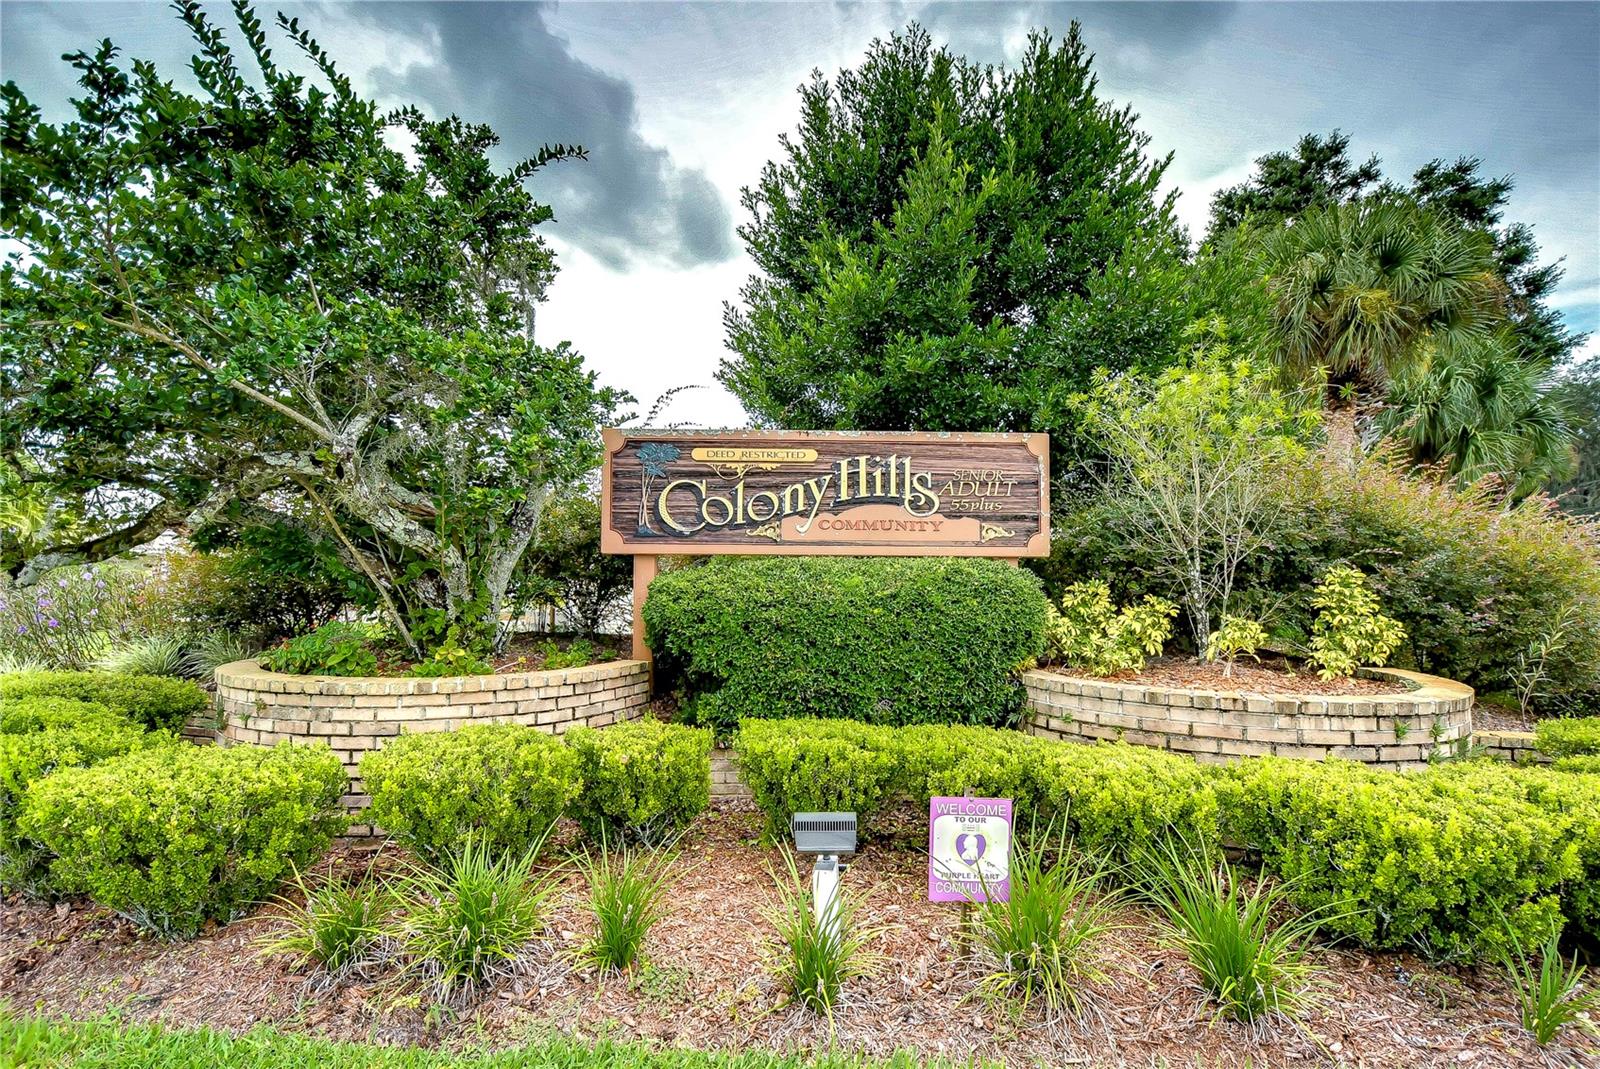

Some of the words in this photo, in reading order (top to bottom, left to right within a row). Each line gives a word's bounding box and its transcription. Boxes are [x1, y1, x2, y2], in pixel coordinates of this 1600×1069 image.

[706, 449, 736, 458] DEED
[741, 450, 807, 459] RESTRICTED
[952, 469, 1004, 481] SENIOR
[658, 475, 832, 534] Colony
[835, 454, 940, 518] Hills
[938, 480, 1019, 497] ADULT
[818, 519, 944, 532] COMMUNITY
[936, 803, 1007, 816] WELCOME
[968, 816, 987, 824] OUR
